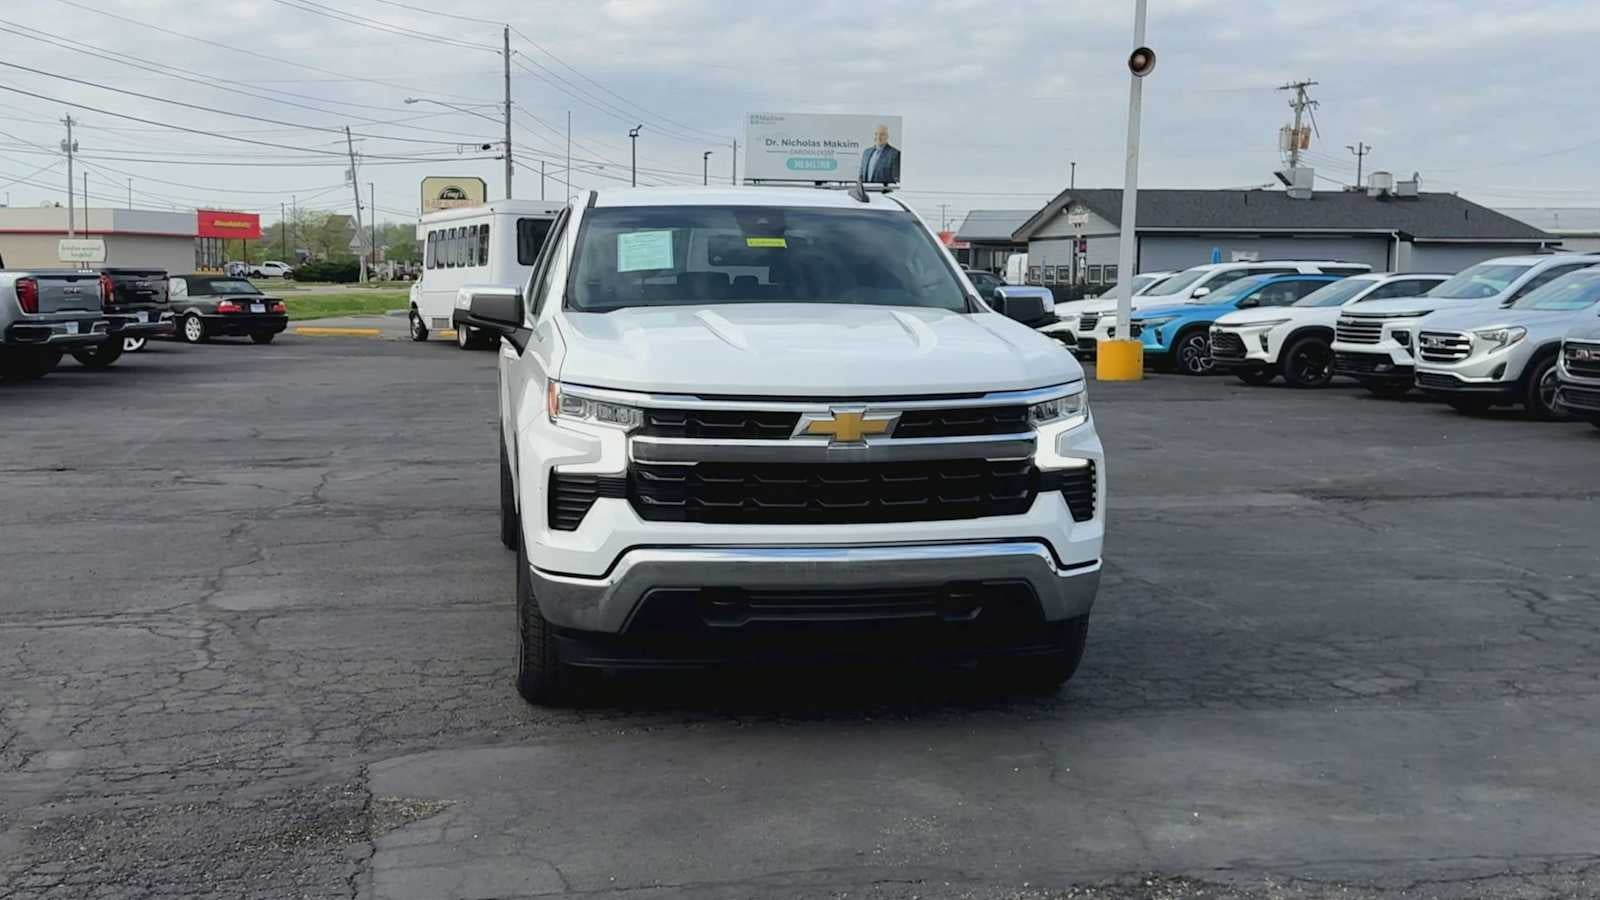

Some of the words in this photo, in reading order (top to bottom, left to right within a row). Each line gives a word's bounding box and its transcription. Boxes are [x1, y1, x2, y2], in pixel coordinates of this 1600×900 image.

[765, 138, 779, 147] Dr.
[781, 138, 821, 148] Nicholas
[823, 139, 860, 149] Maksim
